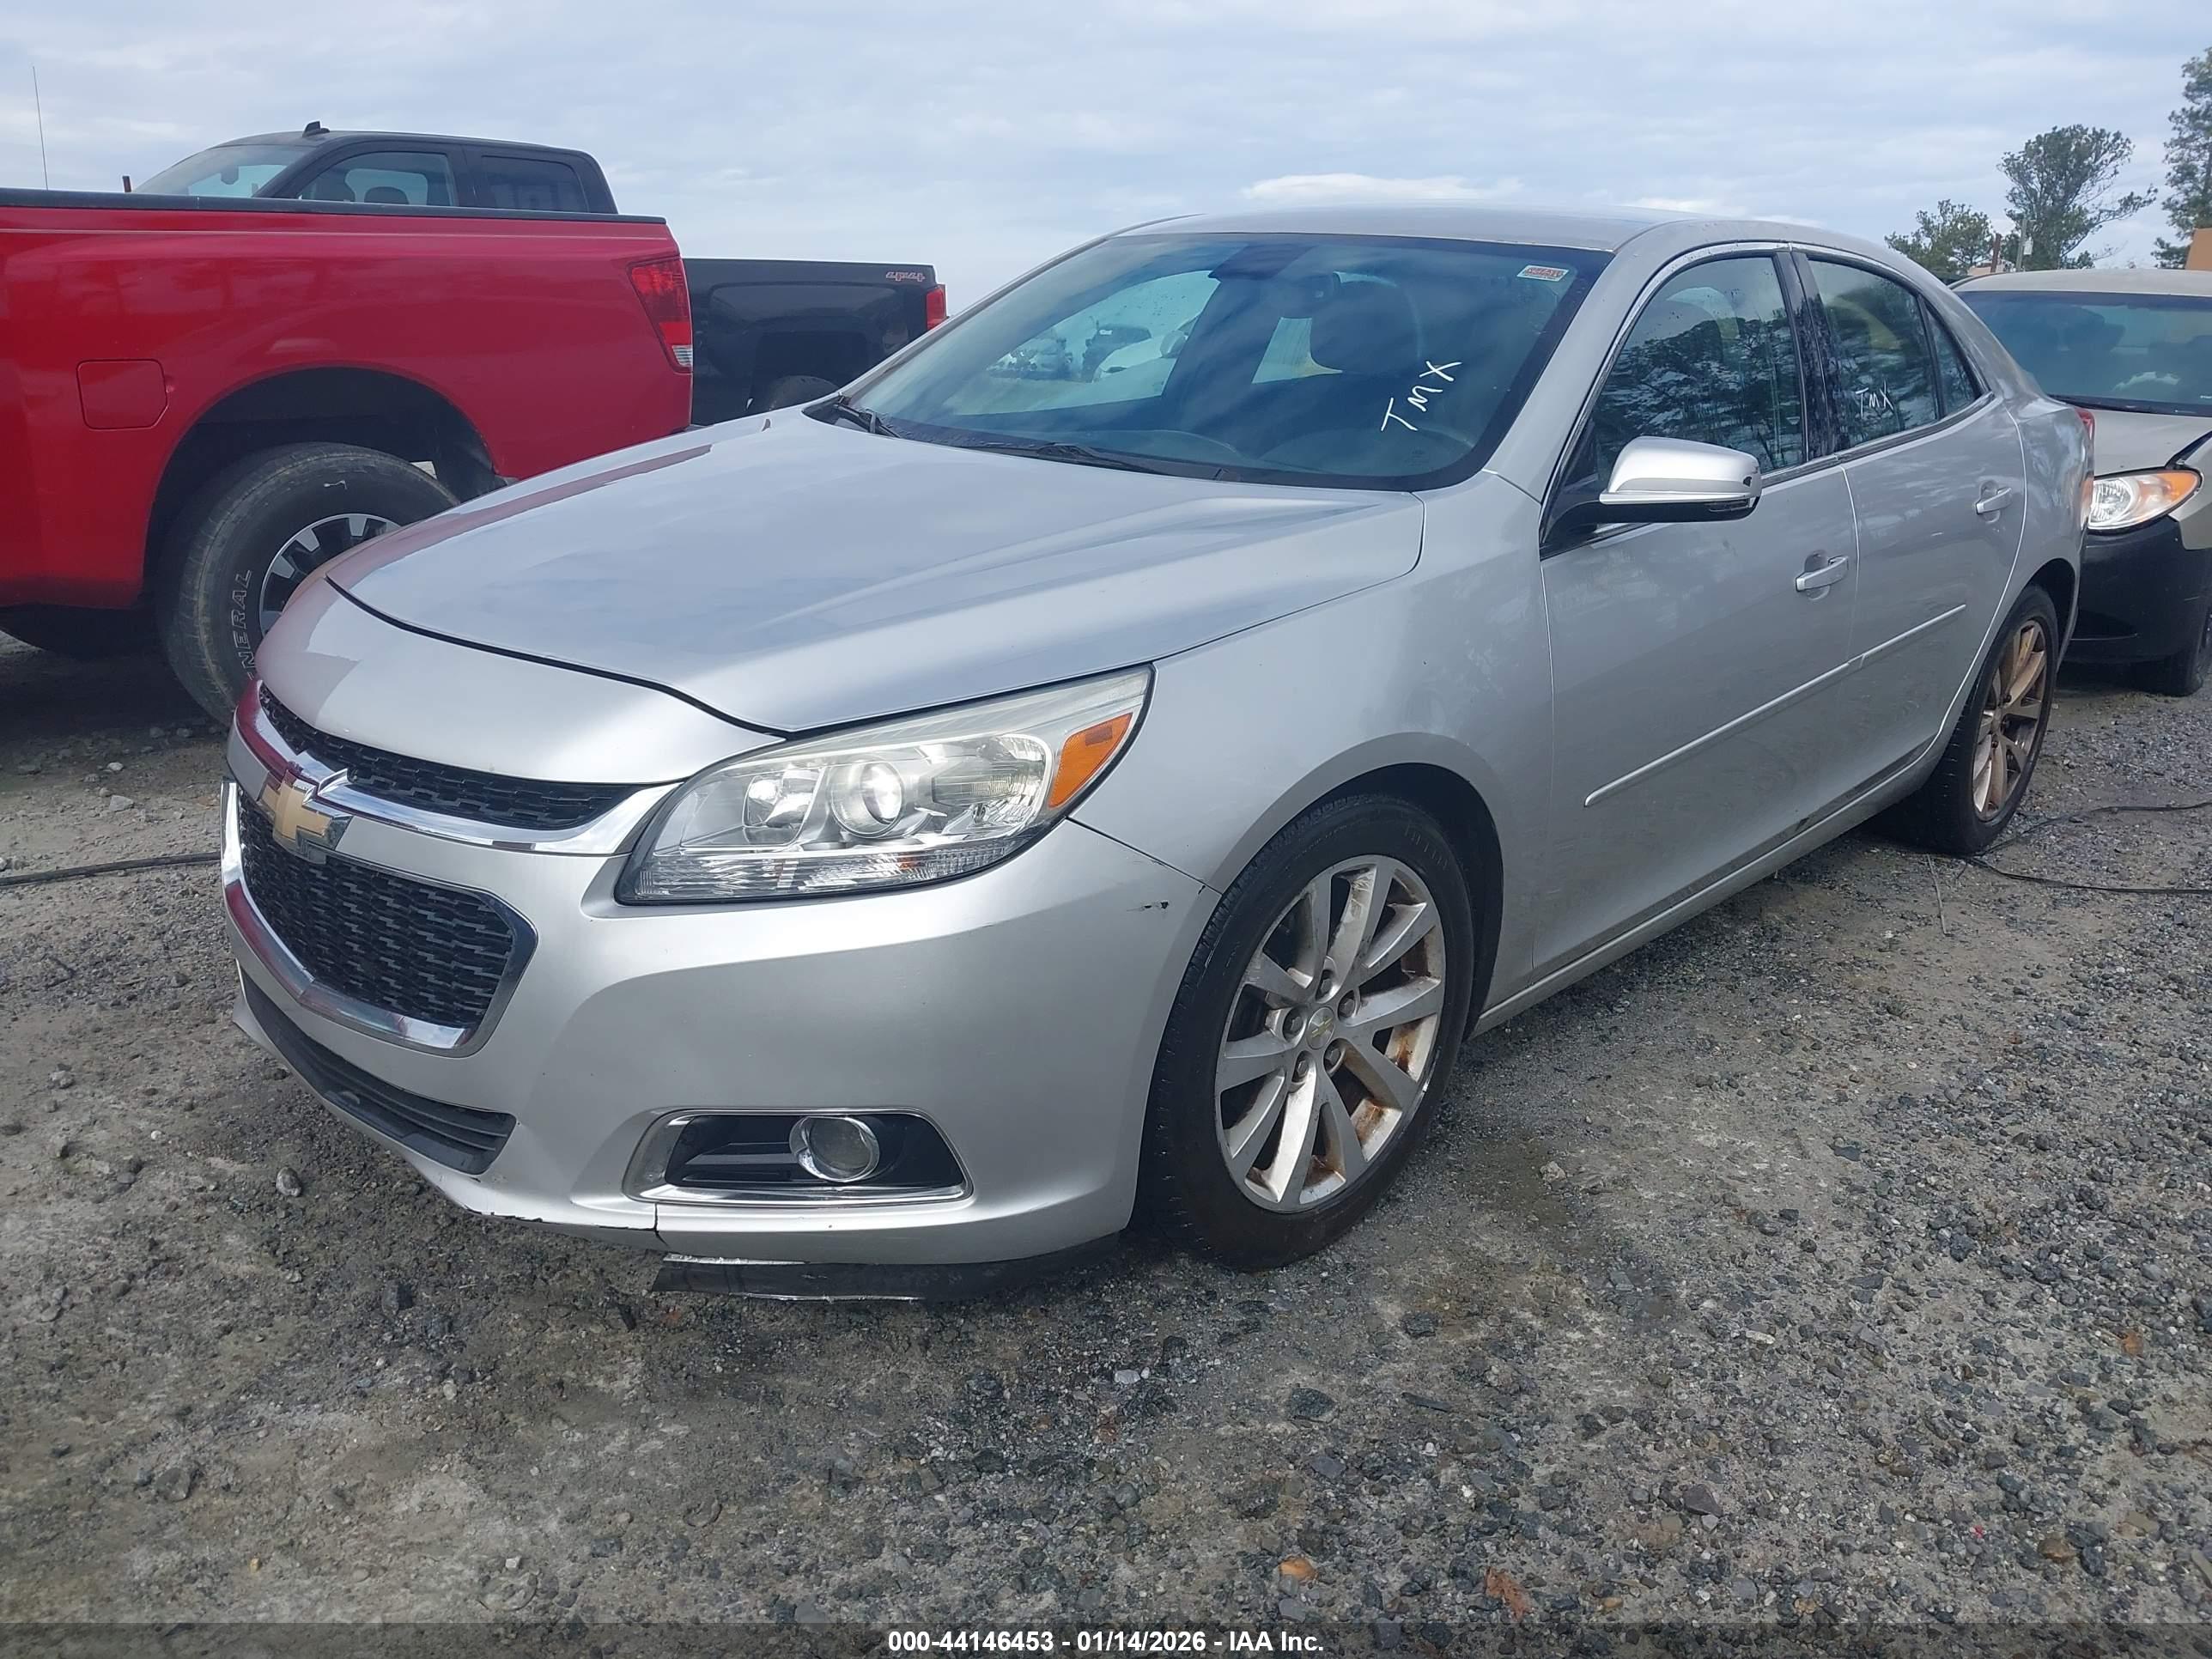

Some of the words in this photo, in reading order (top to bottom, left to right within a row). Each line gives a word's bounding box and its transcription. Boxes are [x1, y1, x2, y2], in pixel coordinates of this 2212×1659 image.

[1380, 360, 1463, 432] TMX
[1855, 379, 1894, 420] TMX
[231, 569, 255, 681] NERAL
